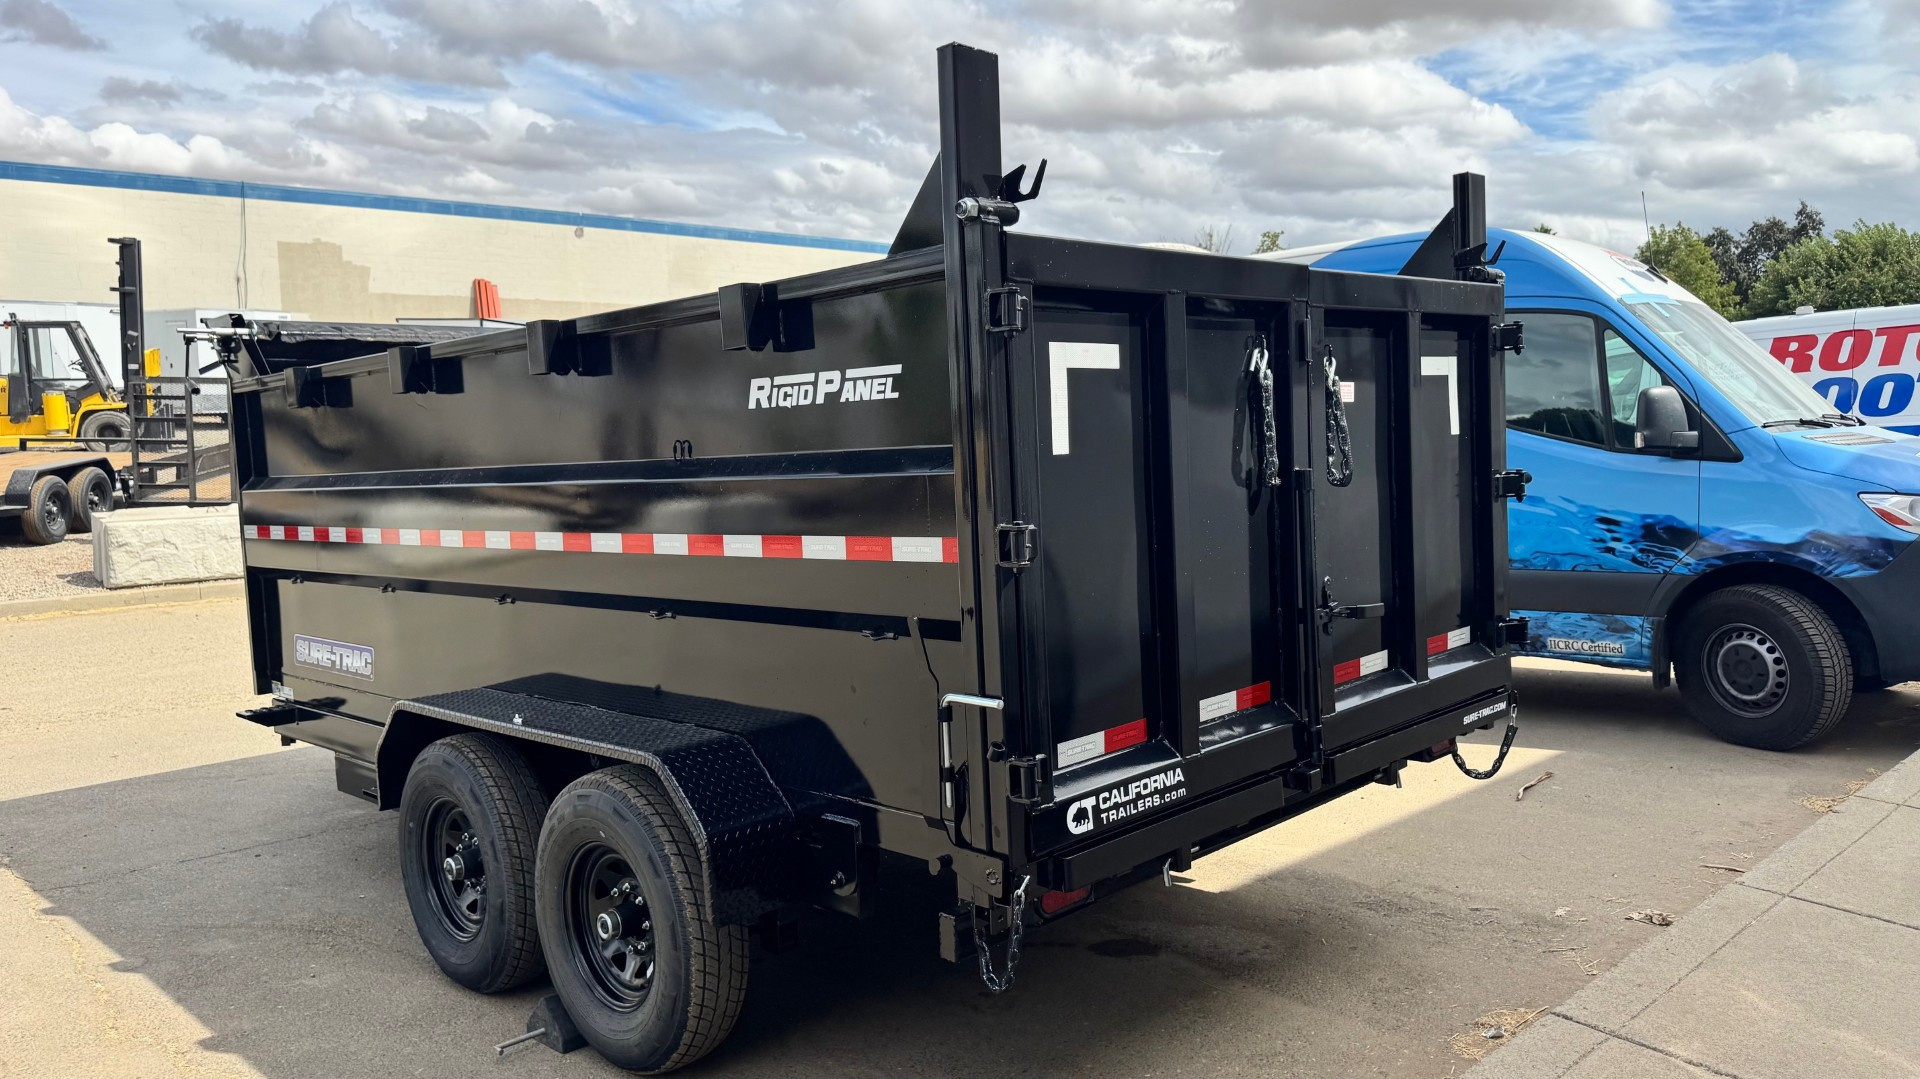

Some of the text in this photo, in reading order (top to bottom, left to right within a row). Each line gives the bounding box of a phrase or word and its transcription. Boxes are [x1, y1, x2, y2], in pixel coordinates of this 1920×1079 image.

[1769, 324, 1920, 373] ROT
[296, 640, 372, 675] SURE-TRAC
[1549, 640, 1623, 653] IICRC Certified
[1463, 701, 1506, 725] SURE-TRAC.COM
[1099, 768, 1184, 809] CALIFORNIA
[1101, 788, 1186, 824] TRAILERS.com
